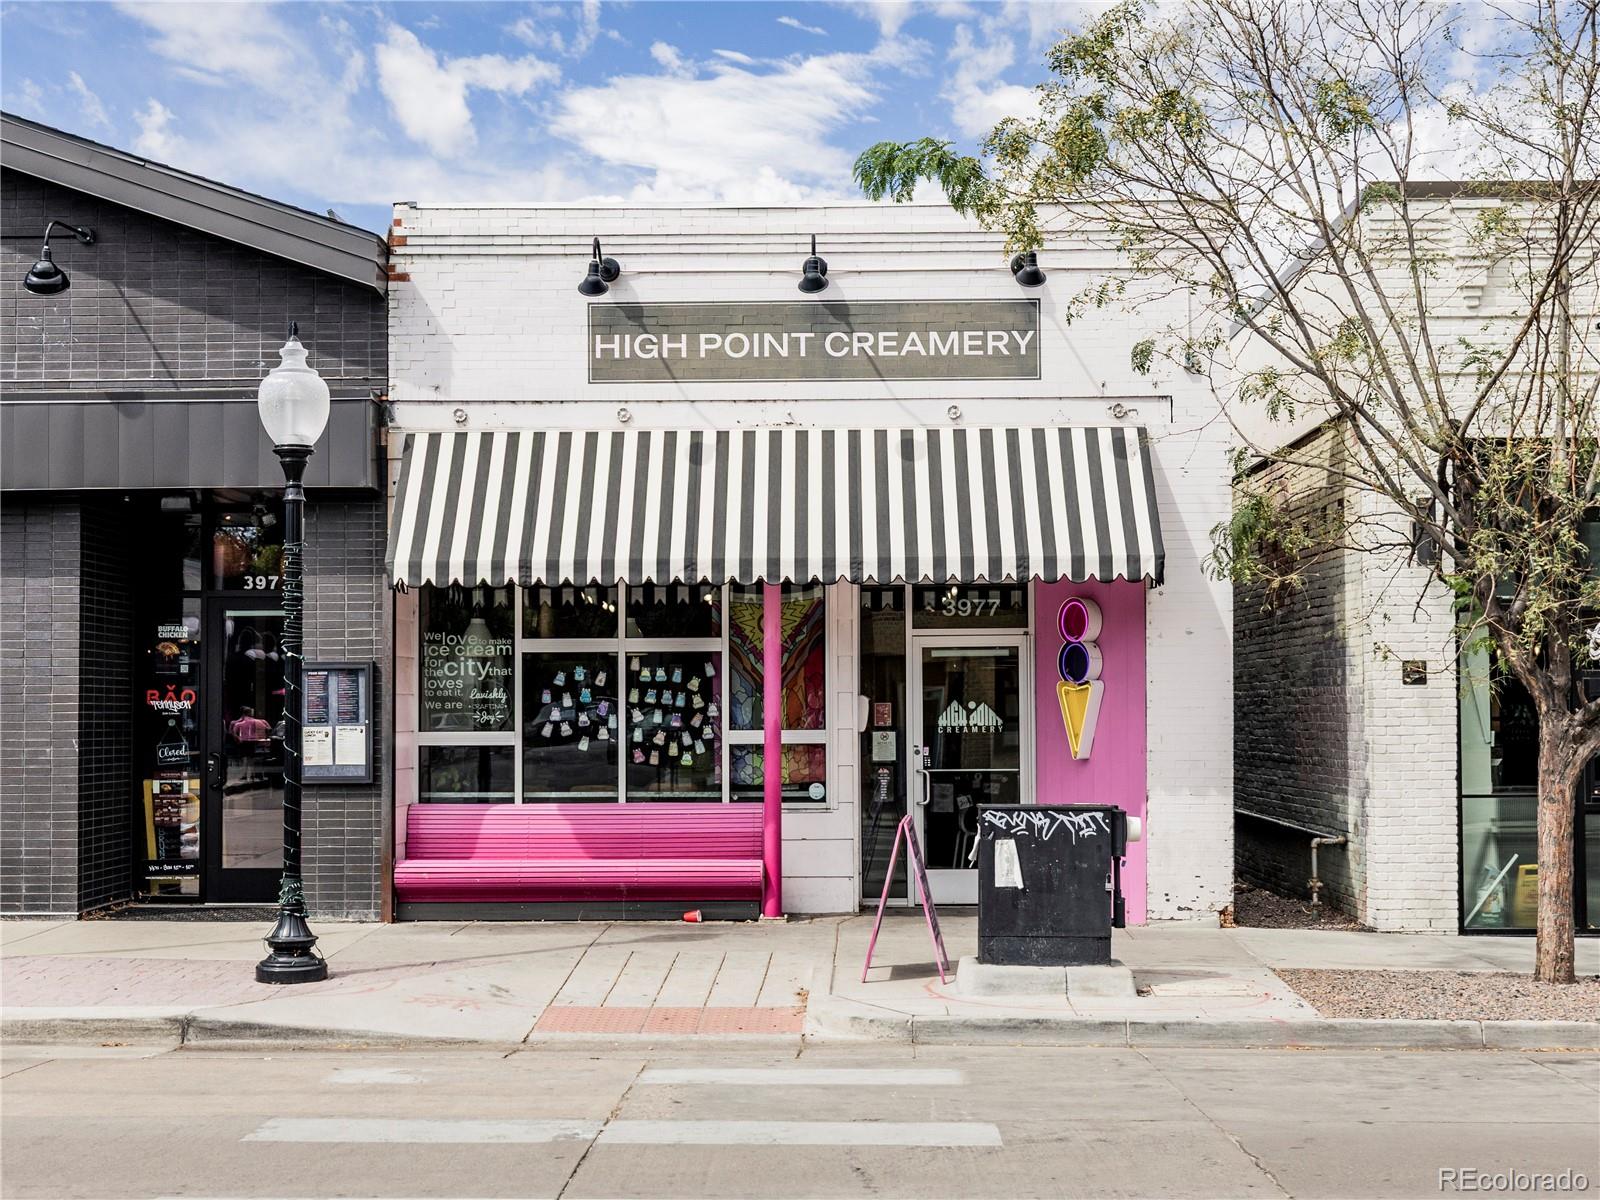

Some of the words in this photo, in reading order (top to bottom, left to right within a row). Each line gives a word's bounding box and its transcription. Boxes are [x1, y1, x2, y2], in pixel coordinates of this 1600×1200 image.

[595, 333, 687, 359] HIGH
[700, 332, 815, 358] POINT
[824, 330, 1035, 357] CREAMERY
[243, 575, 279, 590] 397
[942, 599, 1000, 616] 3977
[424, 632, 442, 640] We
[442, 632, 478, 645] love
[423, 642, 450, 656] ice
[455, 645, 512, 656] cream
[424, 656, 443, 667] for
[424, 668, 444, 677] the
[444, 657, 491, 681] city
[488, 667, 513, 676] that
[424, 678, 463, 689] loves
[424, 701, 442, 710] We
[444, 701, 463, 709] are
[938, 726, 1004, 734] CREAMERY
[159, 744, 187, 758] Closed
